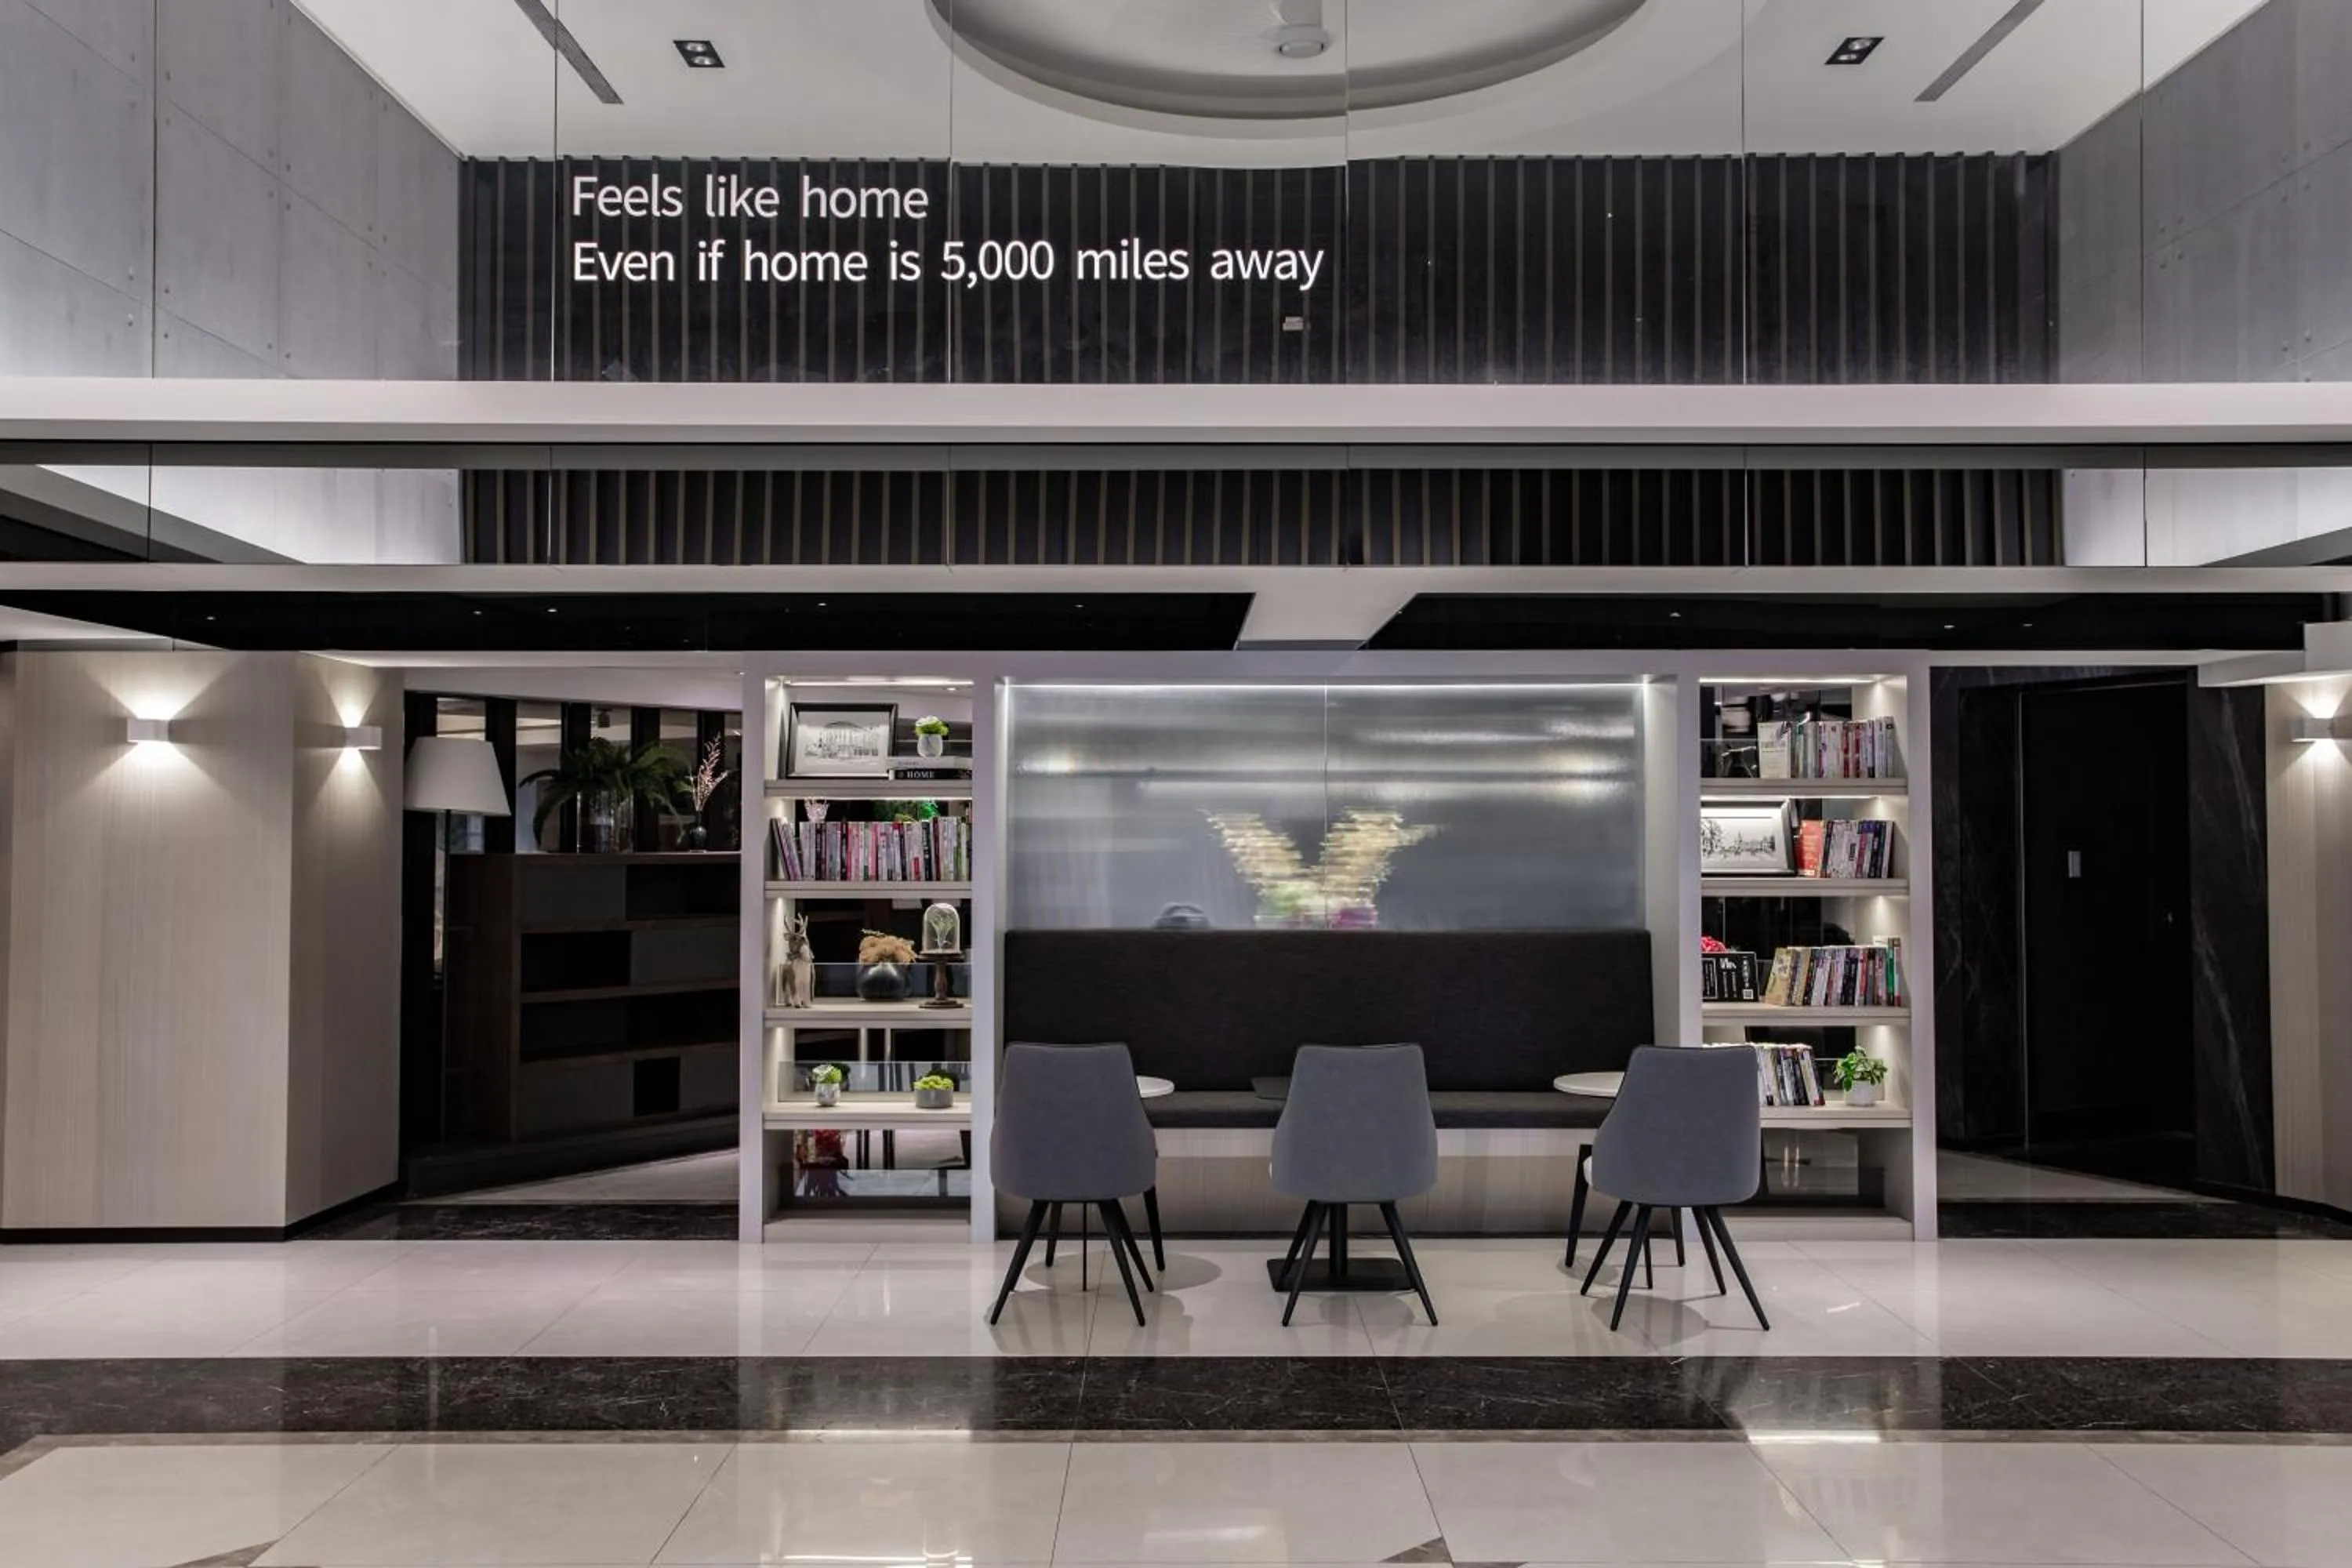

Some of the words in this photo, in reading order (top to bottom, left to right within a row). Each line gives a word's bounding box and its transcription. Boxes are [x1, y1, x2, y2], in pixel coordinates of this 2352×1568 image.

[573, 174, 684, 218] Feels
[706, 174, 780, 219] like
[802, 174, 929, 220] home
[574, 241, 675, 282] Even
[698, 238, 726, 282] if
[744, 239, 868, 282] home
[889, 239, 921, 282] is
[940, 240, 1054, 289] 5,000
[1076, 237, 1190, 281] miles
[1210, 248, 1324, 292] away
